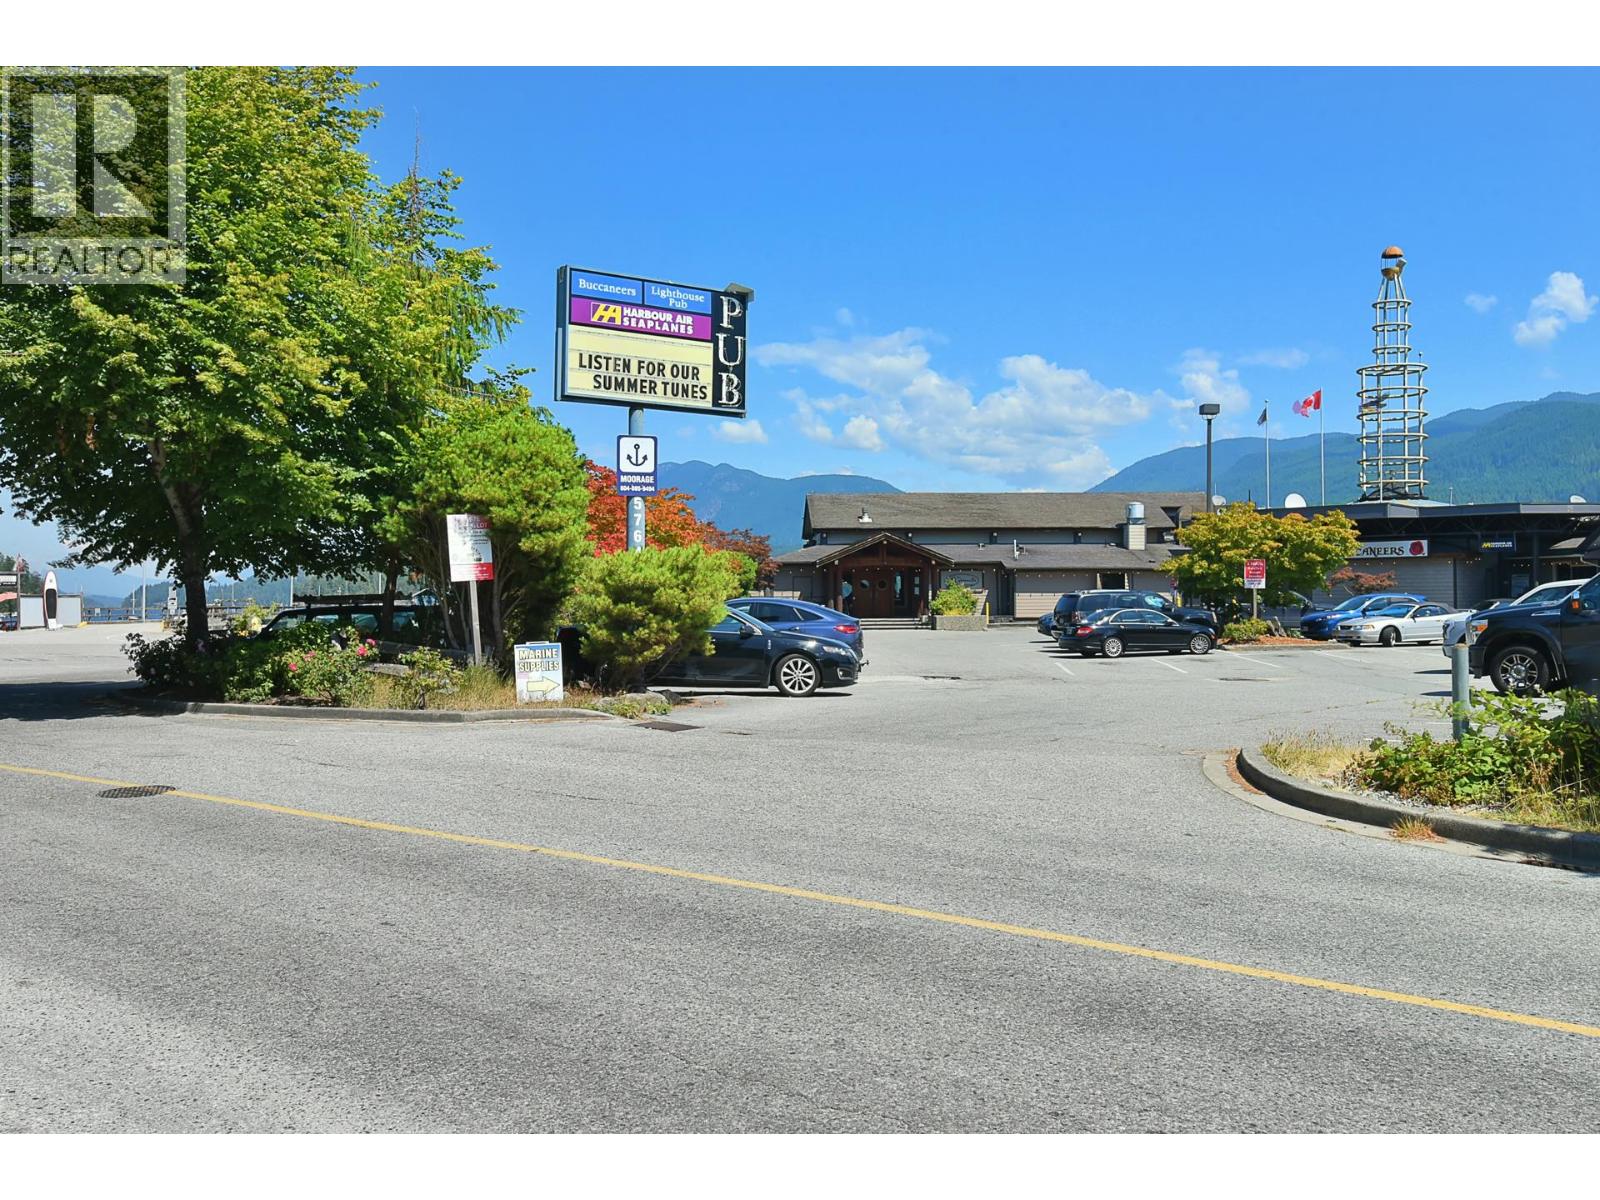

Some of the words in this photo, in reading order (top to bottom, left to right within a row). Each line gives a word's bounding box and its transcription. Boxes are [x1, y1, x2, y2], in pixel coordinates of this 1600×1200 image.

[579, 278, 636, 297] Buccaneers
[651, 286, 705, 303] Lighthouse
[669, 297, 688, 309] Pub
[623, 307, 673, 323] HARBOUR
[675, 314, 693, 325] AIR
[623, 317, 694, 335] SEAPLANES
[578, 352, 631, 373] LISTEN
[637, 360, 666, 377] FOR
[670, 364, 700, 381] OUR
[593, 374, 658, 395] SUMMER
[661, 381, 708, 400] TUNES
[620, 475, 655, 484] MOORAGE
[519, 648, 558, 660] MARINE
[519, 660, 560, 672] SUPPLIES
